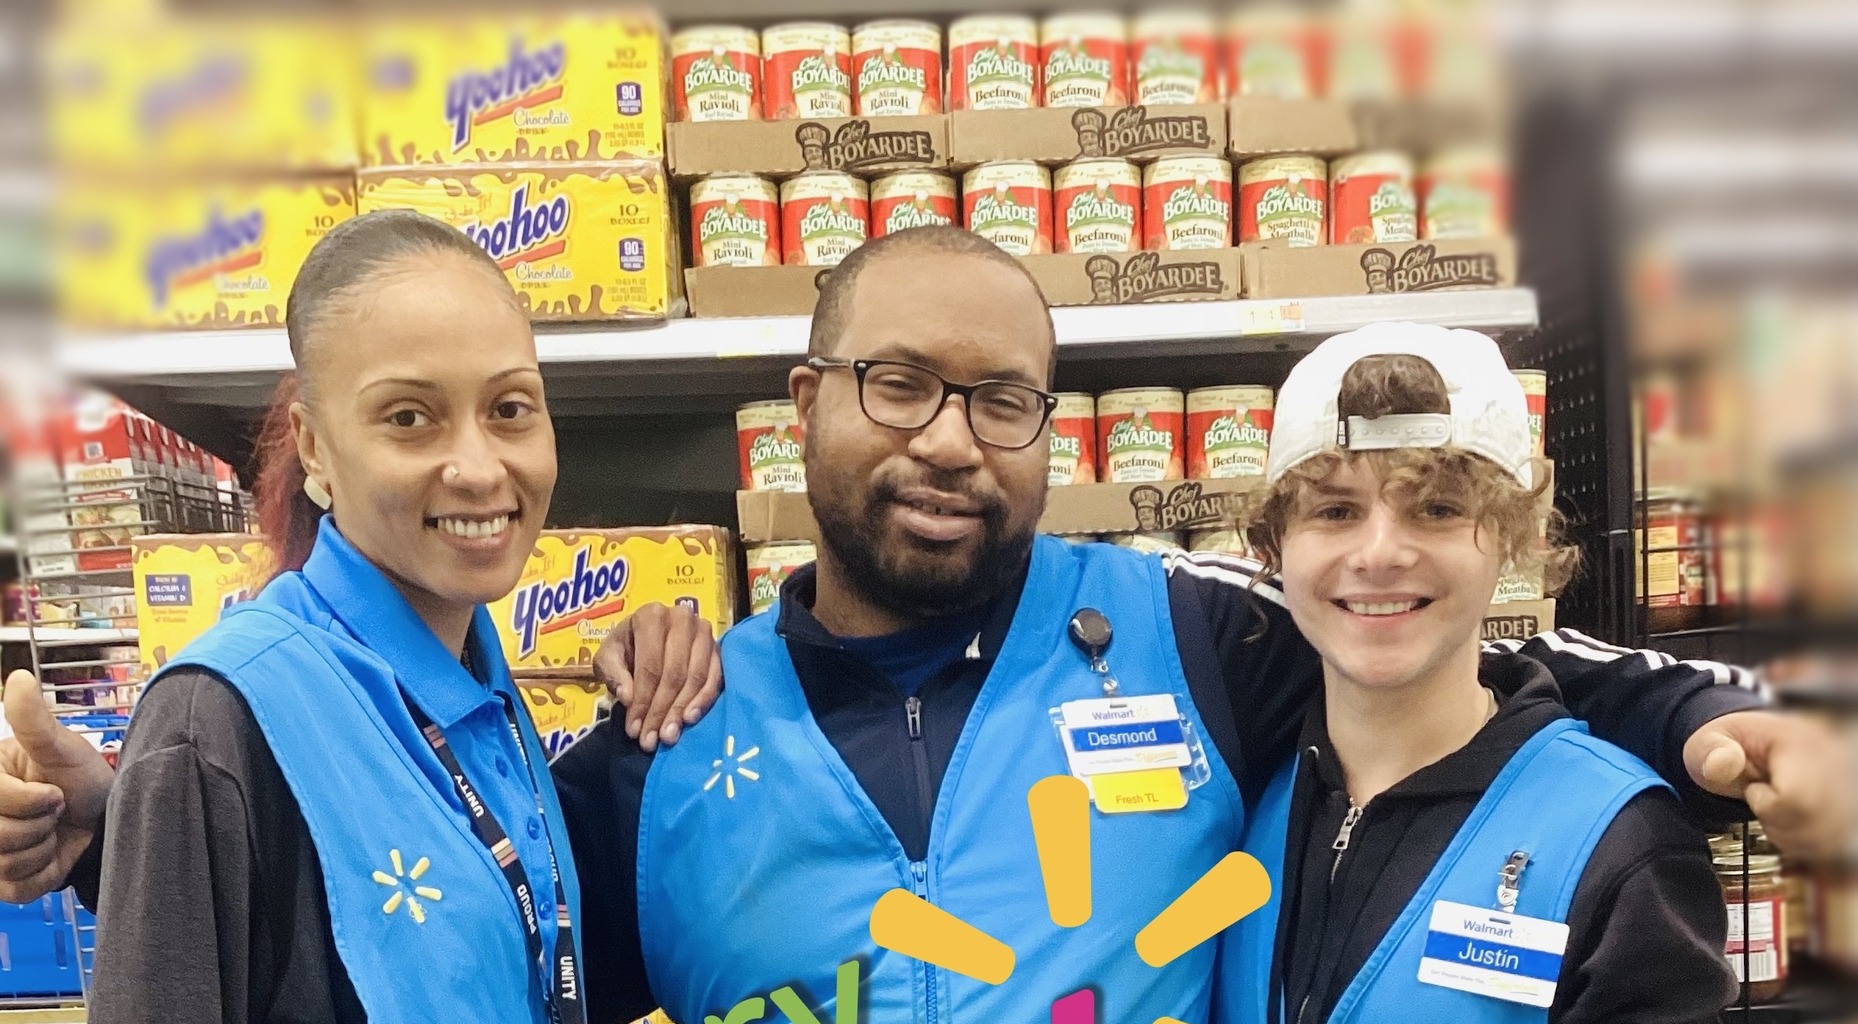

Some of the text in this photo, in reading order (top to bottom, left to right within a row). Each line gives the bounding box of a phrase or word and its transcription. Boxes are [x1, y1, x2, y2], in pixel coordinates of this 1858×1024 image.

[690, 57, 713, 73] Chef
[799, 56, 821, 71] Chef
[974, 49, 994, 64] Chef
[858, 65, 926, 92] BOYARDEE
[967, 59, 1034, 84] BOYARDEE
[1045, 56, 1111, 84] BOYARDEE
[685, 67, 753, 93] BOYARDEE
[621, 85, 636, 99] 90
[709, 92, 728, 100] Mini
[879, 89, 897, 98] Mini
[975, 85, 1027, 103] Beefaroni
[1050, 84, 1101, 102] Beefaroni
[699, 99, 742, 113] Ravioli
[809, 98, 846, 113] Ravioli
[870, 96, 909, 111] Ravioli
[513, 109, 570, 125] Chocolate
[1115, 110, 1143, 130] Chef
[838, 125, 867, 146] Chef
[1105, 120, 1206, 153] BOYARDEE
[829, 134, 931, 169] BOYARDEE
[1074, 191, 1094, 208] Chef
[1171, 187, 1193, 202] Chef
[1263, 186, 1285, 200] Chef
[620, 204, 639, 216] 10
[892, 203, 913, 218] Chef
[975, 195, 994, 210] Chef
[1163, 198, 1229, 223] BOYARDEE
[1257, 195, 1323, 219] BOYARDEE
[706, 206, 724, 222] Chef
[808, 205, 829, 220] Chef
[971, 204, 1037, 231] BOYARDEE
[1067, 202, 1134, 228] BOYARDEE
[315, 216, 334, 228] 10
[466, 187, 566, 256] oohoo
[700, 215, 768, 239] BOYARDEE
[801, 215, 867, 238] BOYARDEE
[1268, 217, 1310, 232] Spaghetti
[1075, 229, 1127, 246] Beefaroni
[1172, 223, 1223, 241] Beefaroni
[624, 241, 639, 255] 90
[722, 240, 741, 248] Mini
[826, 238, 846, 247] Mini
[713, 247, 752, 261] Ravioli
[1403, 250, 1431, 268] Chef
[515, 263, 572, 279] Chocolate
[1127, 256, 1155, 277] Chef
[1392, 258, 1496, 292] BOYARDEE
[1118, 266, 1220, 300] BOYARDEE
[1112, 416, 1132, 433] Chef
[1212, 416, 1233, 431] Chef
[754, 434, 773, 448] Chef
[1107, 428, 1173, 453] BOYARDEE
[1204, 427, 1269, 449] BOYARDEE
[750, 443, 800, 467] BOYARD
[1113, 454, 1165, 472] Beefaroni
[1212, 451, 1263, 468] Beefaroni
[772, 465, 791, 474] Mini
[763, 472, 803, 486] Ravioli
[1171, 486, 1198, 505] Chef
[1162, 497, 1232, 530] BOYAR
[676, 565, 694, 577] 10
[667, 577, 705, 585] BOXES!
[753, 574, 769, 588] Chef
[150, 594, 177, 602] VITAMIN
[751, 584, 780, 605] BOYA
[1091, 709, 1135, 721] Walmart
[1087, 727, 1158, 747] Desmond
[454, 774, 485, 818] UNITY
[1116, 793, 1159, 805] Fresh TL
[517, 884, 537, 935] PROUD
[1463, 919, 1514, 939] Walmart
[1458, 941, 1519, 970] Justin
[559, 955, 577, 1000] UNITY
